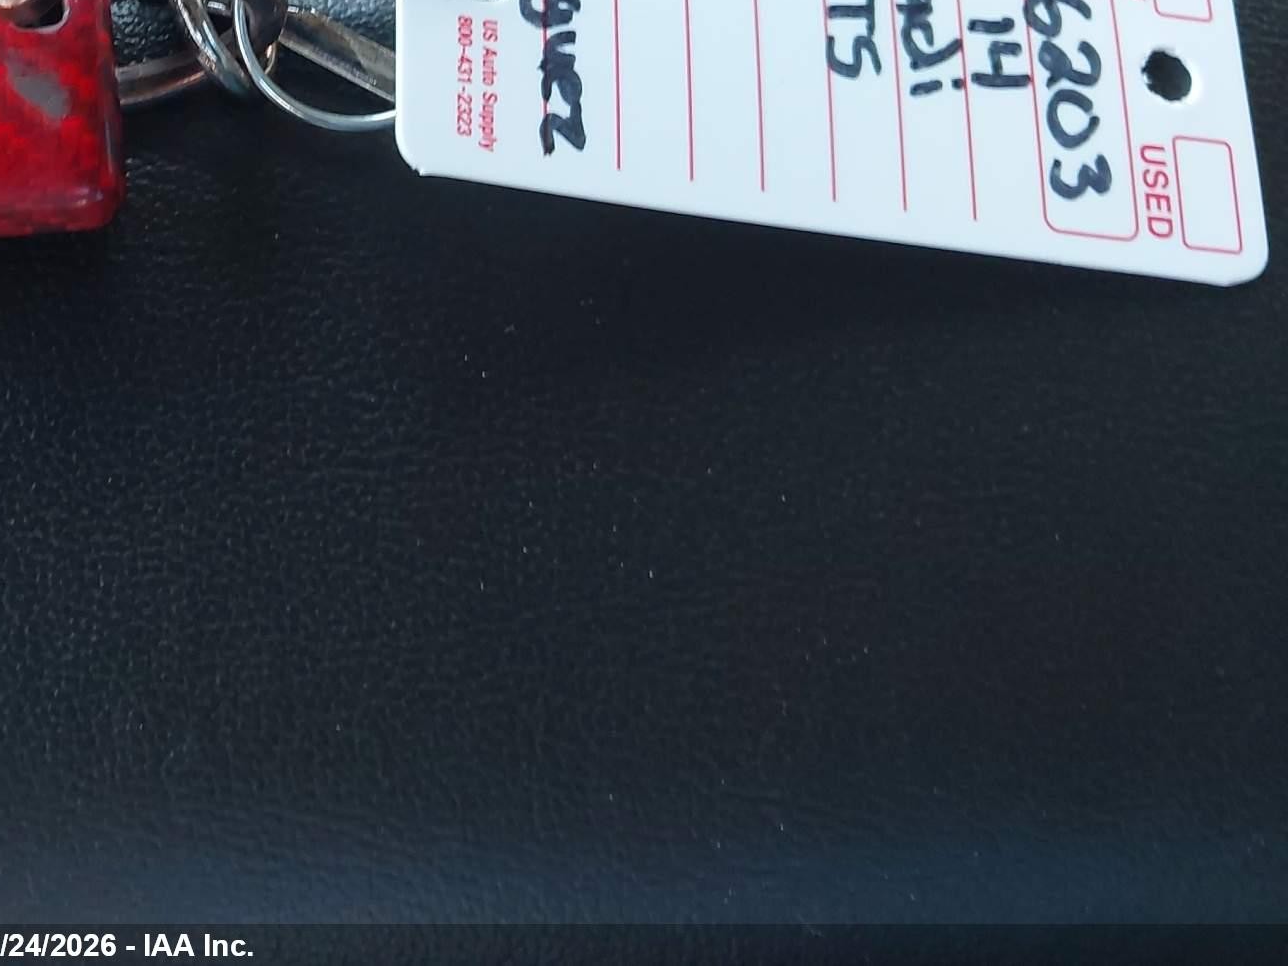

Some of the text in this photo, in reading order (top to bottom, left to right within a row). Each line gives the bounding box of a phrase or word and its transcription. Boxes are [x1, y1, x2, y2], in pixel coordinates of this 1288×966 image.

[457, 16, 472, 136] 800-431-2323
[479, 20, 498, 152] US Auto Supply
[968, 18, 1031, 88] 14
[1140, 144, 1173, 238] USED
